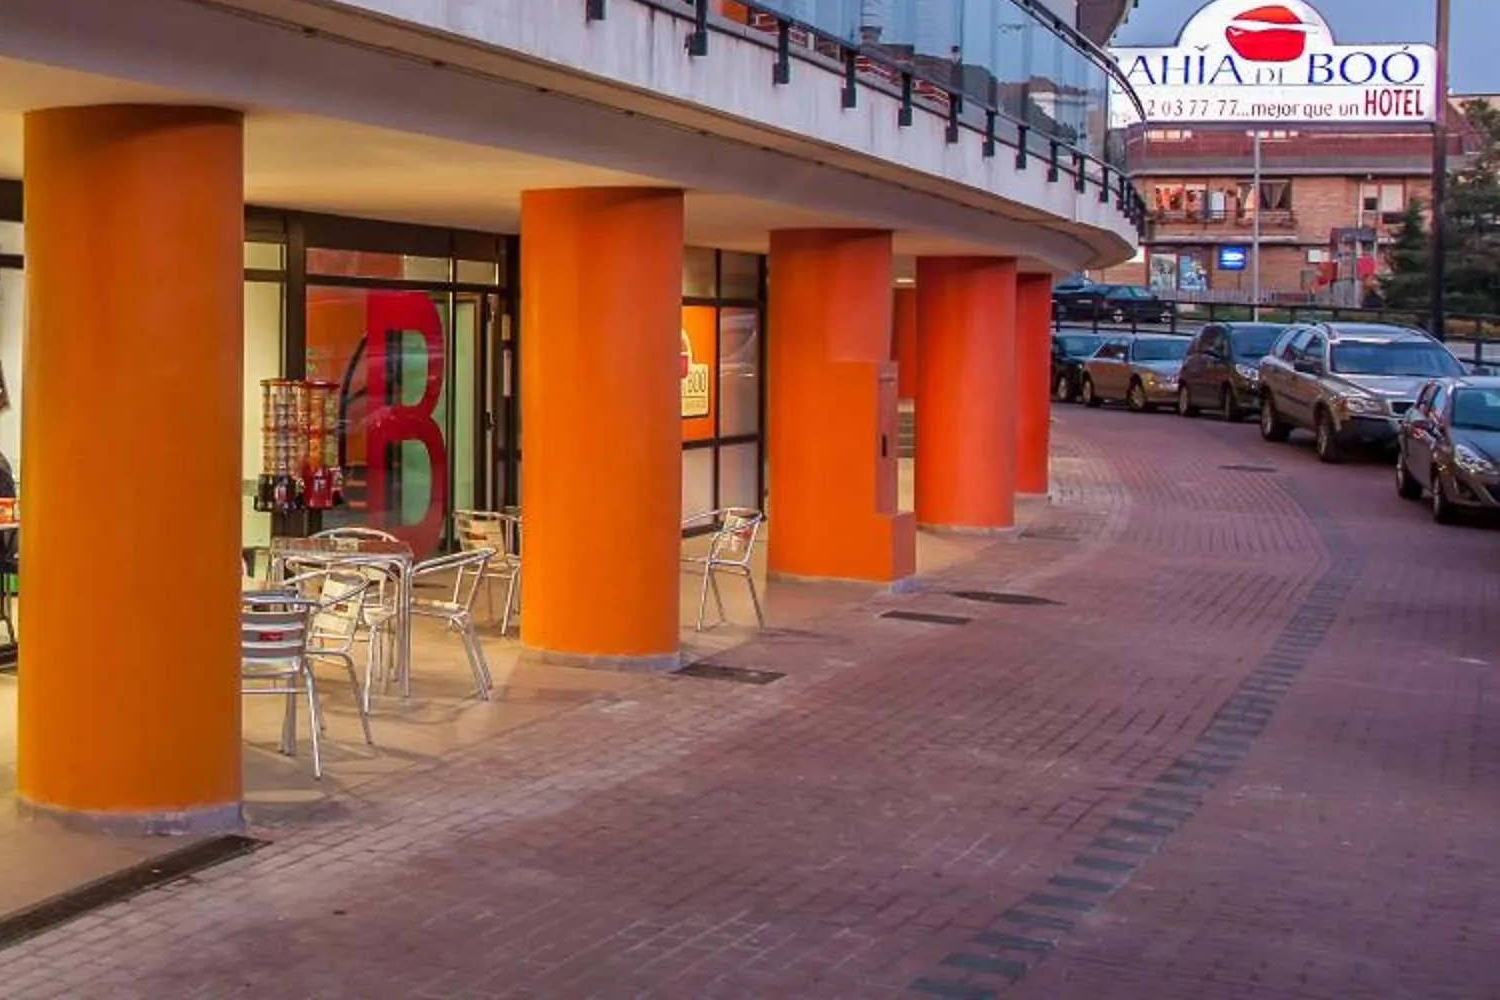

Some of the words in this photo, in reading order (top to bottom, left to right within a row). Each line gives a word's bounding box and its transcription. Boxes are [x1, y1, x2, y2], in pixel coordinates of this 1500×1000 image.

[1112, 44, 1243, 85] AHÍA
[1307, 45, 1420, 86] BOÓ
[1302, 102, 1333, 119] que
[1338, 102, 1360, 117] un
[1363, 88, 1425, 117] HOTEL
